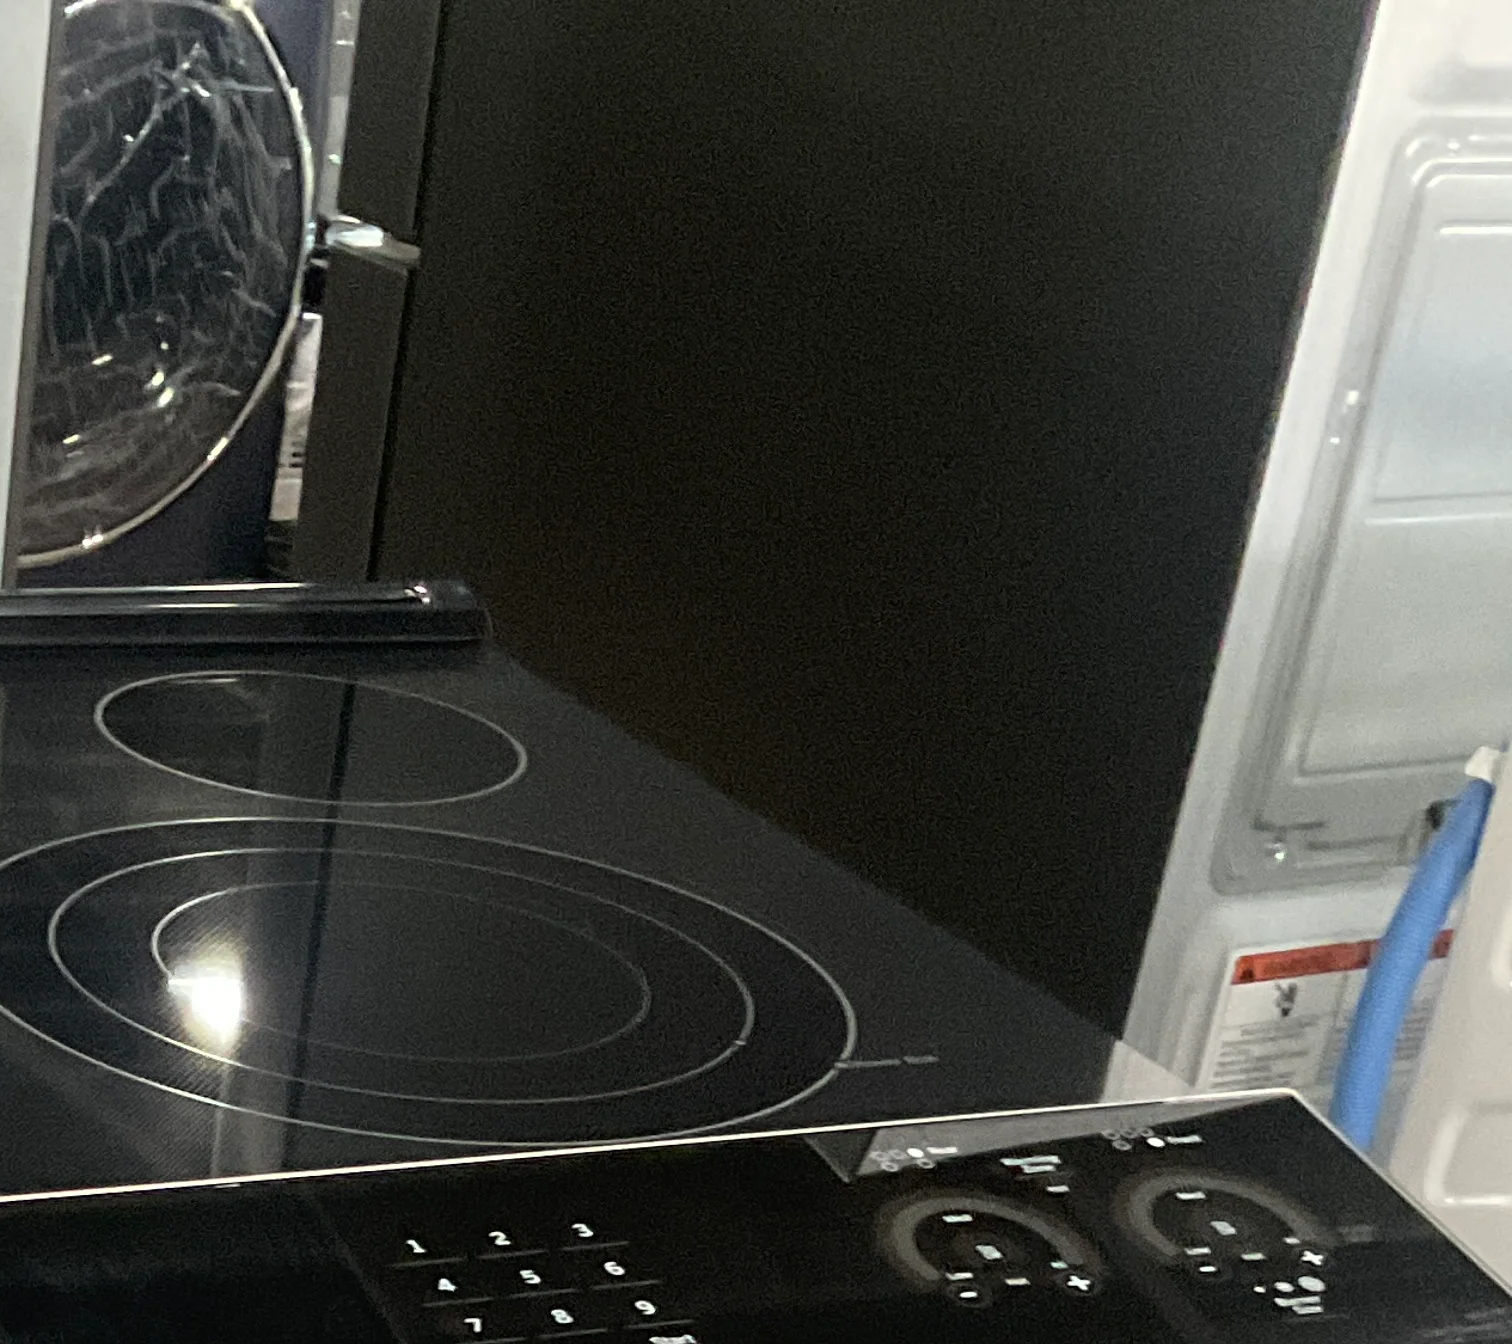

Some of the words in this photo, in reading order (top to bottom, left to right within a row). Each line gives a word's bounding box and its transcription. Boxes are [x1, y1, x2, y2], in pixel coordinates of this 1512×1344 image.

[571, 1223, 594, 1238] 3
[488, 1231, 512, 1246] 2
[406, 1239, 427, 1254] 1
[603, 1261, 626, 1276] 6
[519, 1269, 542, 1285] 5
[437, 1278, 458, 1292] 4
[634, 1300, 657, 1315] 9
[550, 1308, 575, 1324] 8
[463, 1317, 482, 1333] 7
